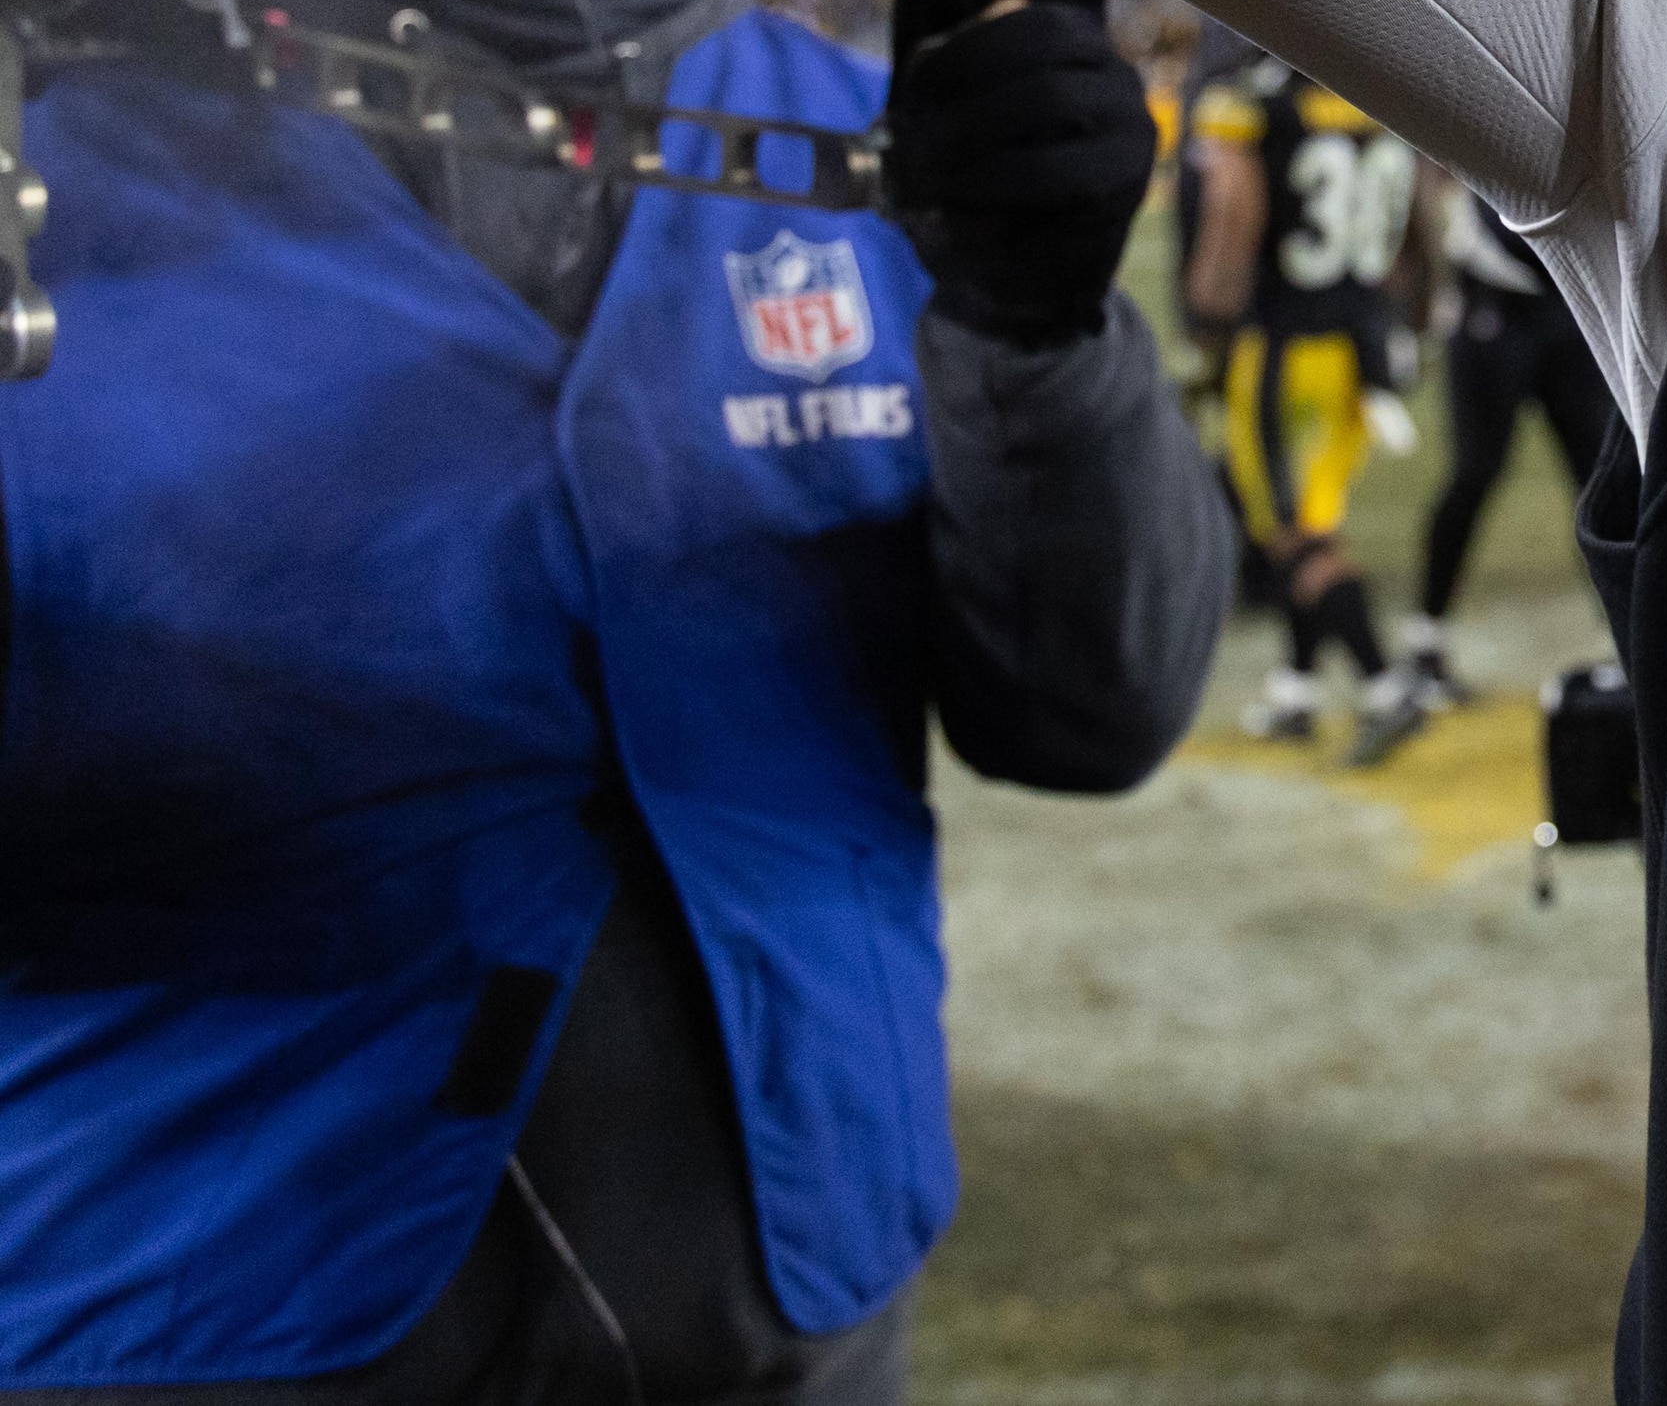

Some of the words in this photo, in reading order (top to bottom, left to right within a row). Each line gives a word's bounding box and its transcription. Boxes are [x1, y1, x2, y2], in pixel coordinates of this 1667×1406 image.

[1277, 131, 1417, 290] 30
[752, 291, 855, 358] NFL
[722, 393, 798, 448] NFL
